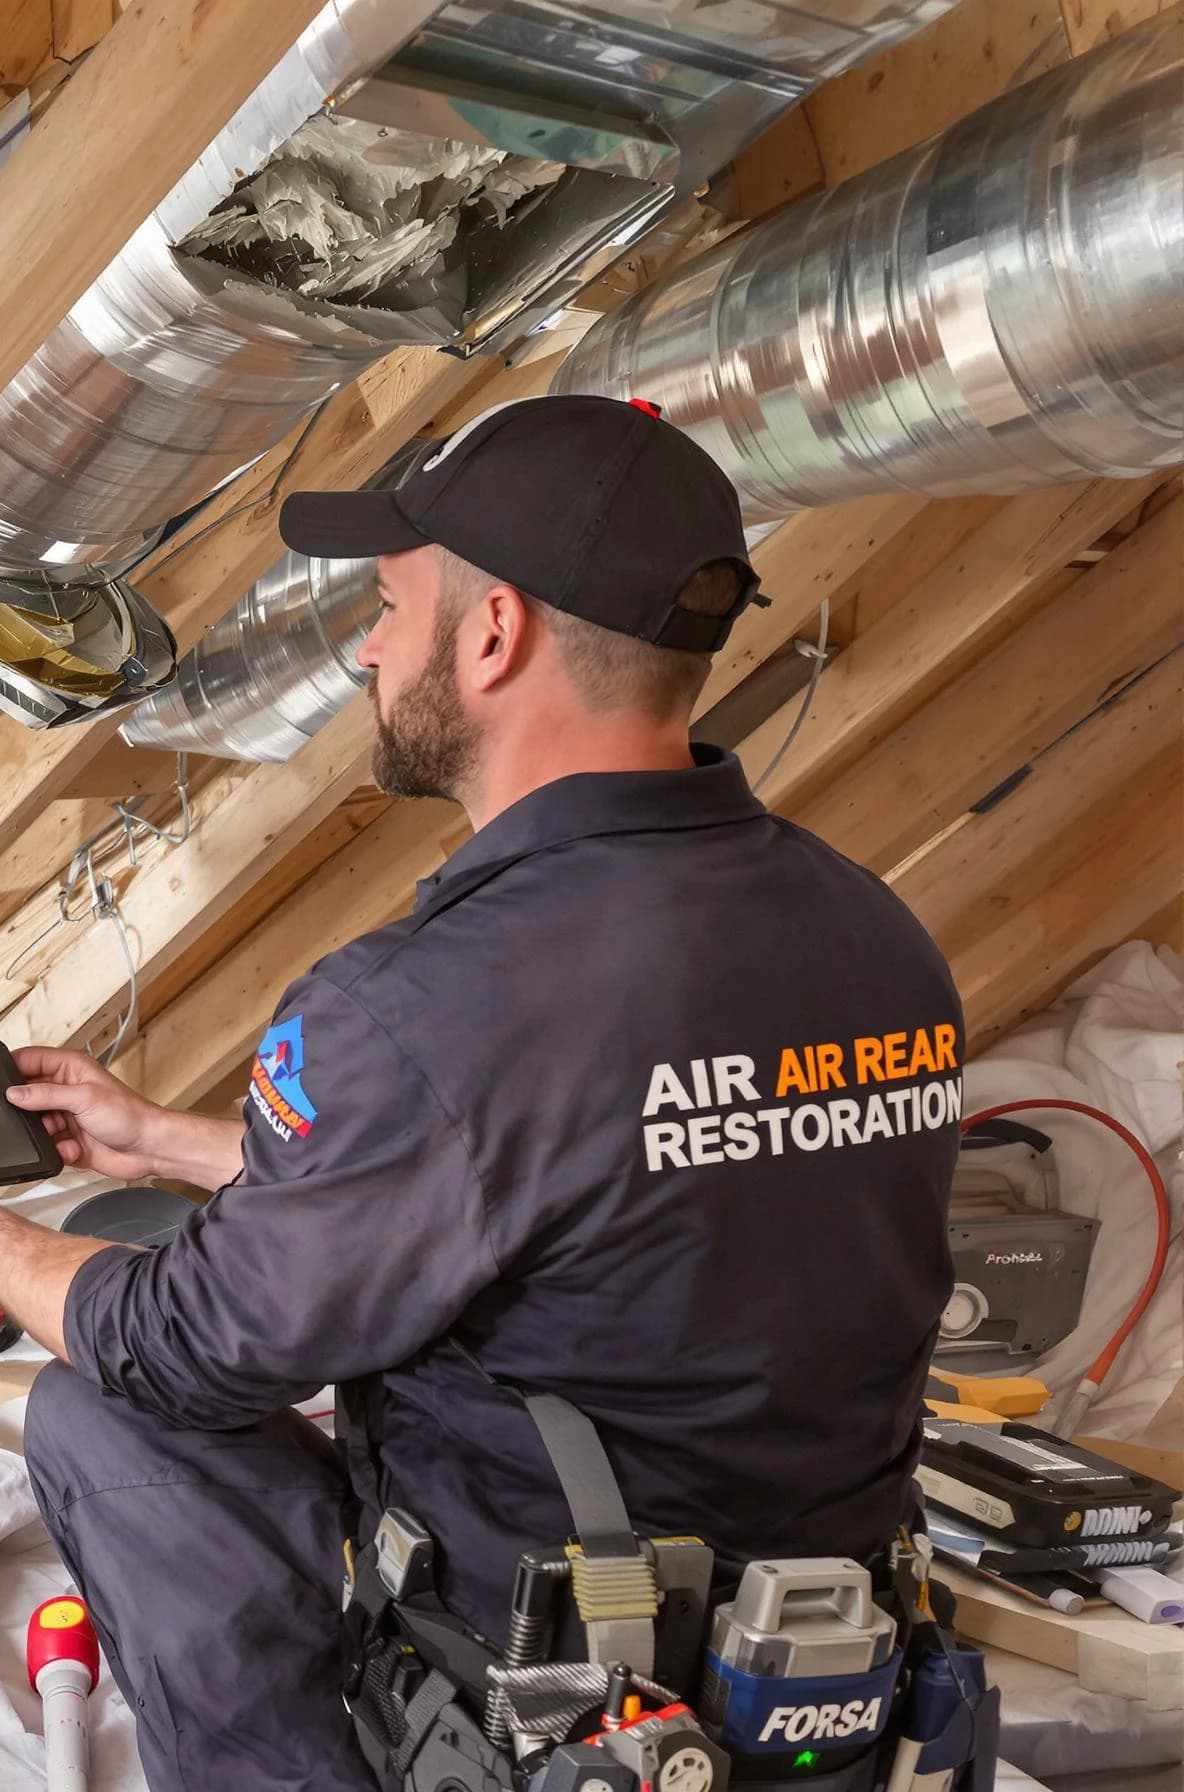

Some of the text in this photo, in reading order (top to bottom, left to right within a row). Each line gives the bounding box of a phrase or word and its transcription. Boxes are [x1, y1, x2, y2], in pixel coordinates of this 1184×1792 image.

[642, 1024, 958, 1117] AIR AIR REAR
[643, 1078, 962, 1172] RESTORATION
[759, 1697, 882, 1743] FORSA
